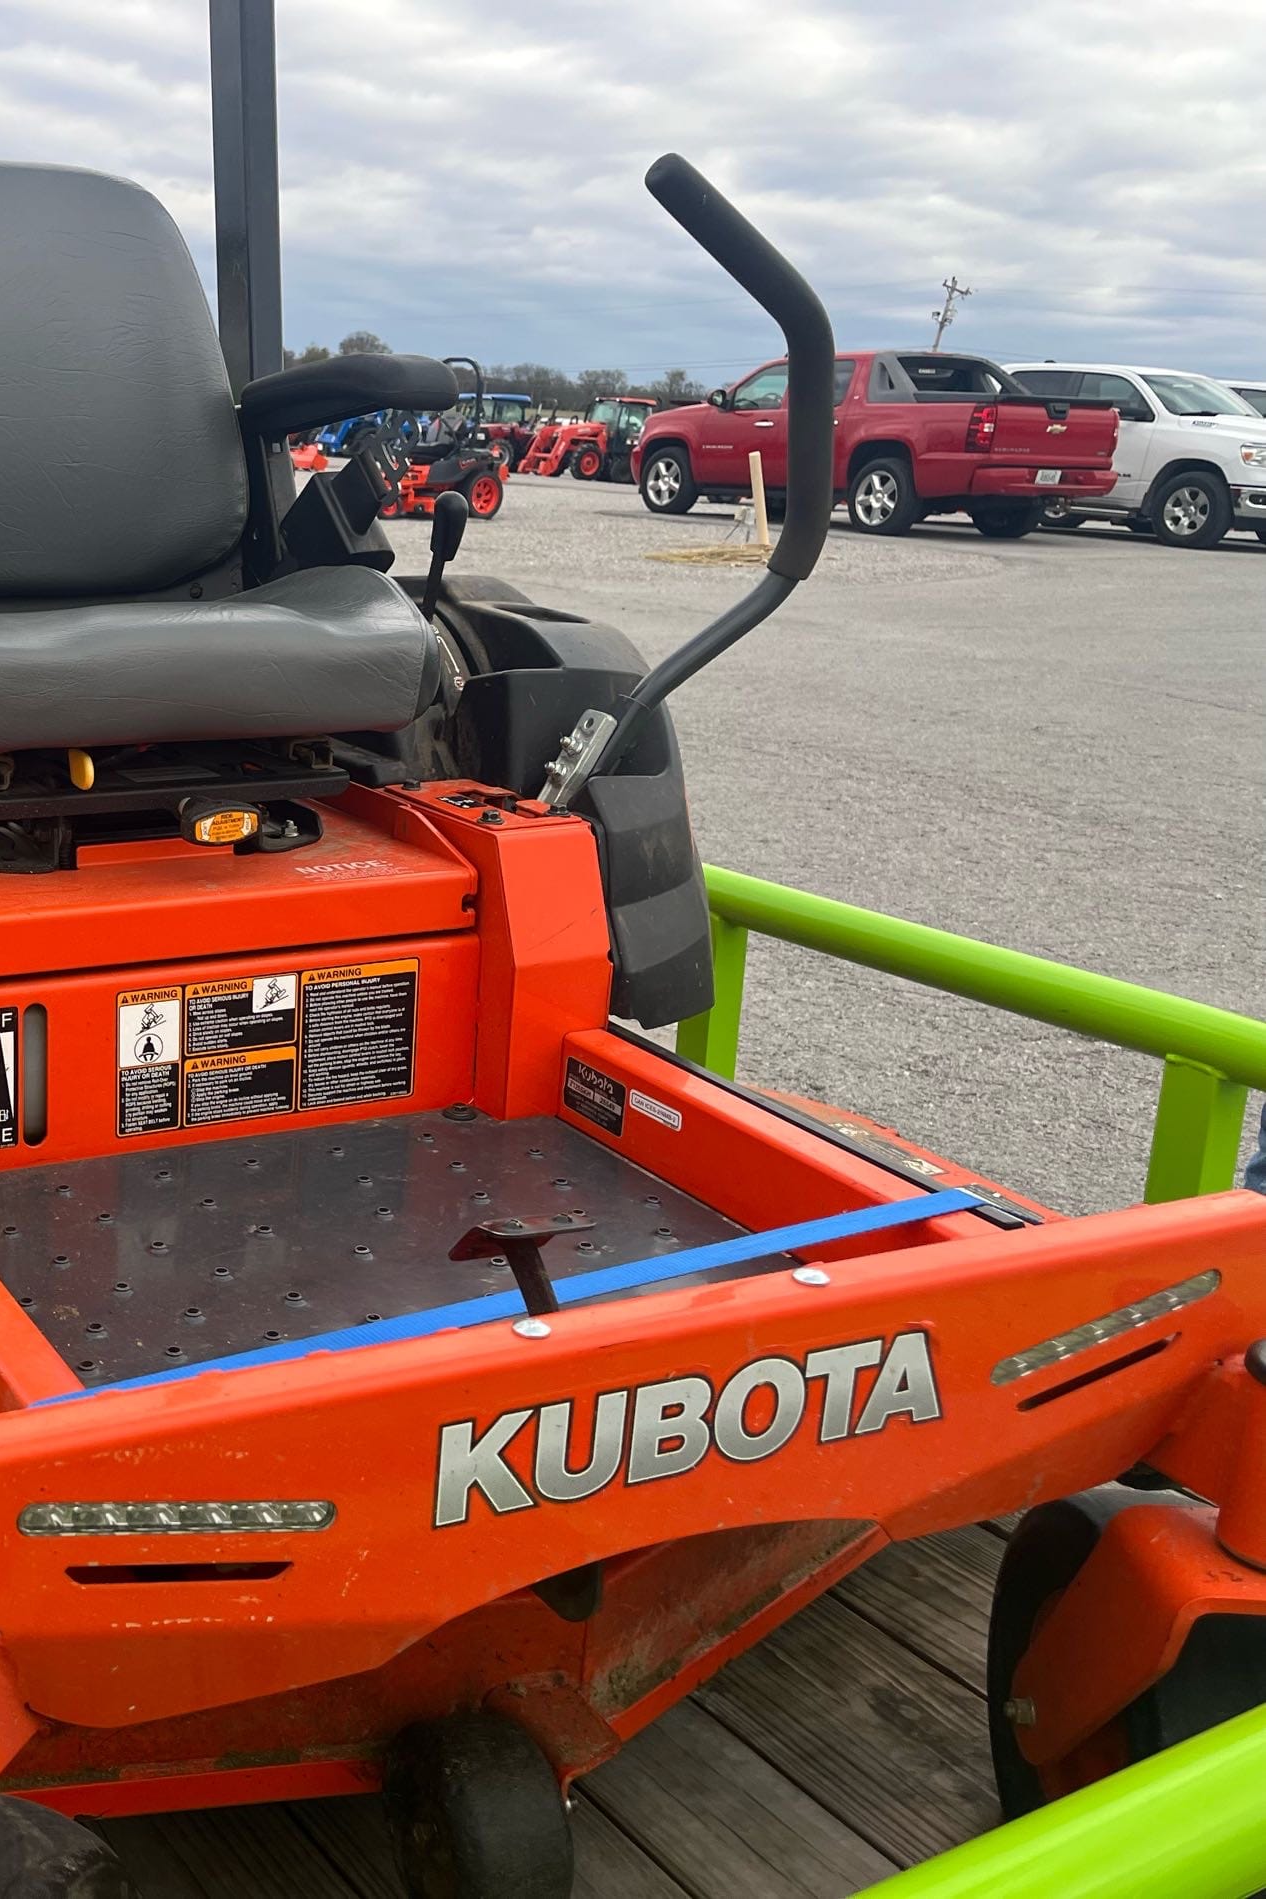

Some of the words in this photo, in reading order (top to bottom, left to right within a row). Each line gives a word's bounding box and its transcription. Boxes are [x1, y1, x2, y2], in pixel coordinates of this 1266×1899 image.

[295, 859, 394, 875] NOTICE:
[317, 967, 362, 980] WARNING
[201, 981, 248, 994] WARNING
[130, 989, 178, 1003] WARNING
[1, 1012, 13, 1028] F
[200, 1055, 247, 1068] WARNING
[578, 1063, 614, 1095] Kubota
[1, 1127, 14, 1143] E
[432, 1330, 943, 1529] KUBOTA
